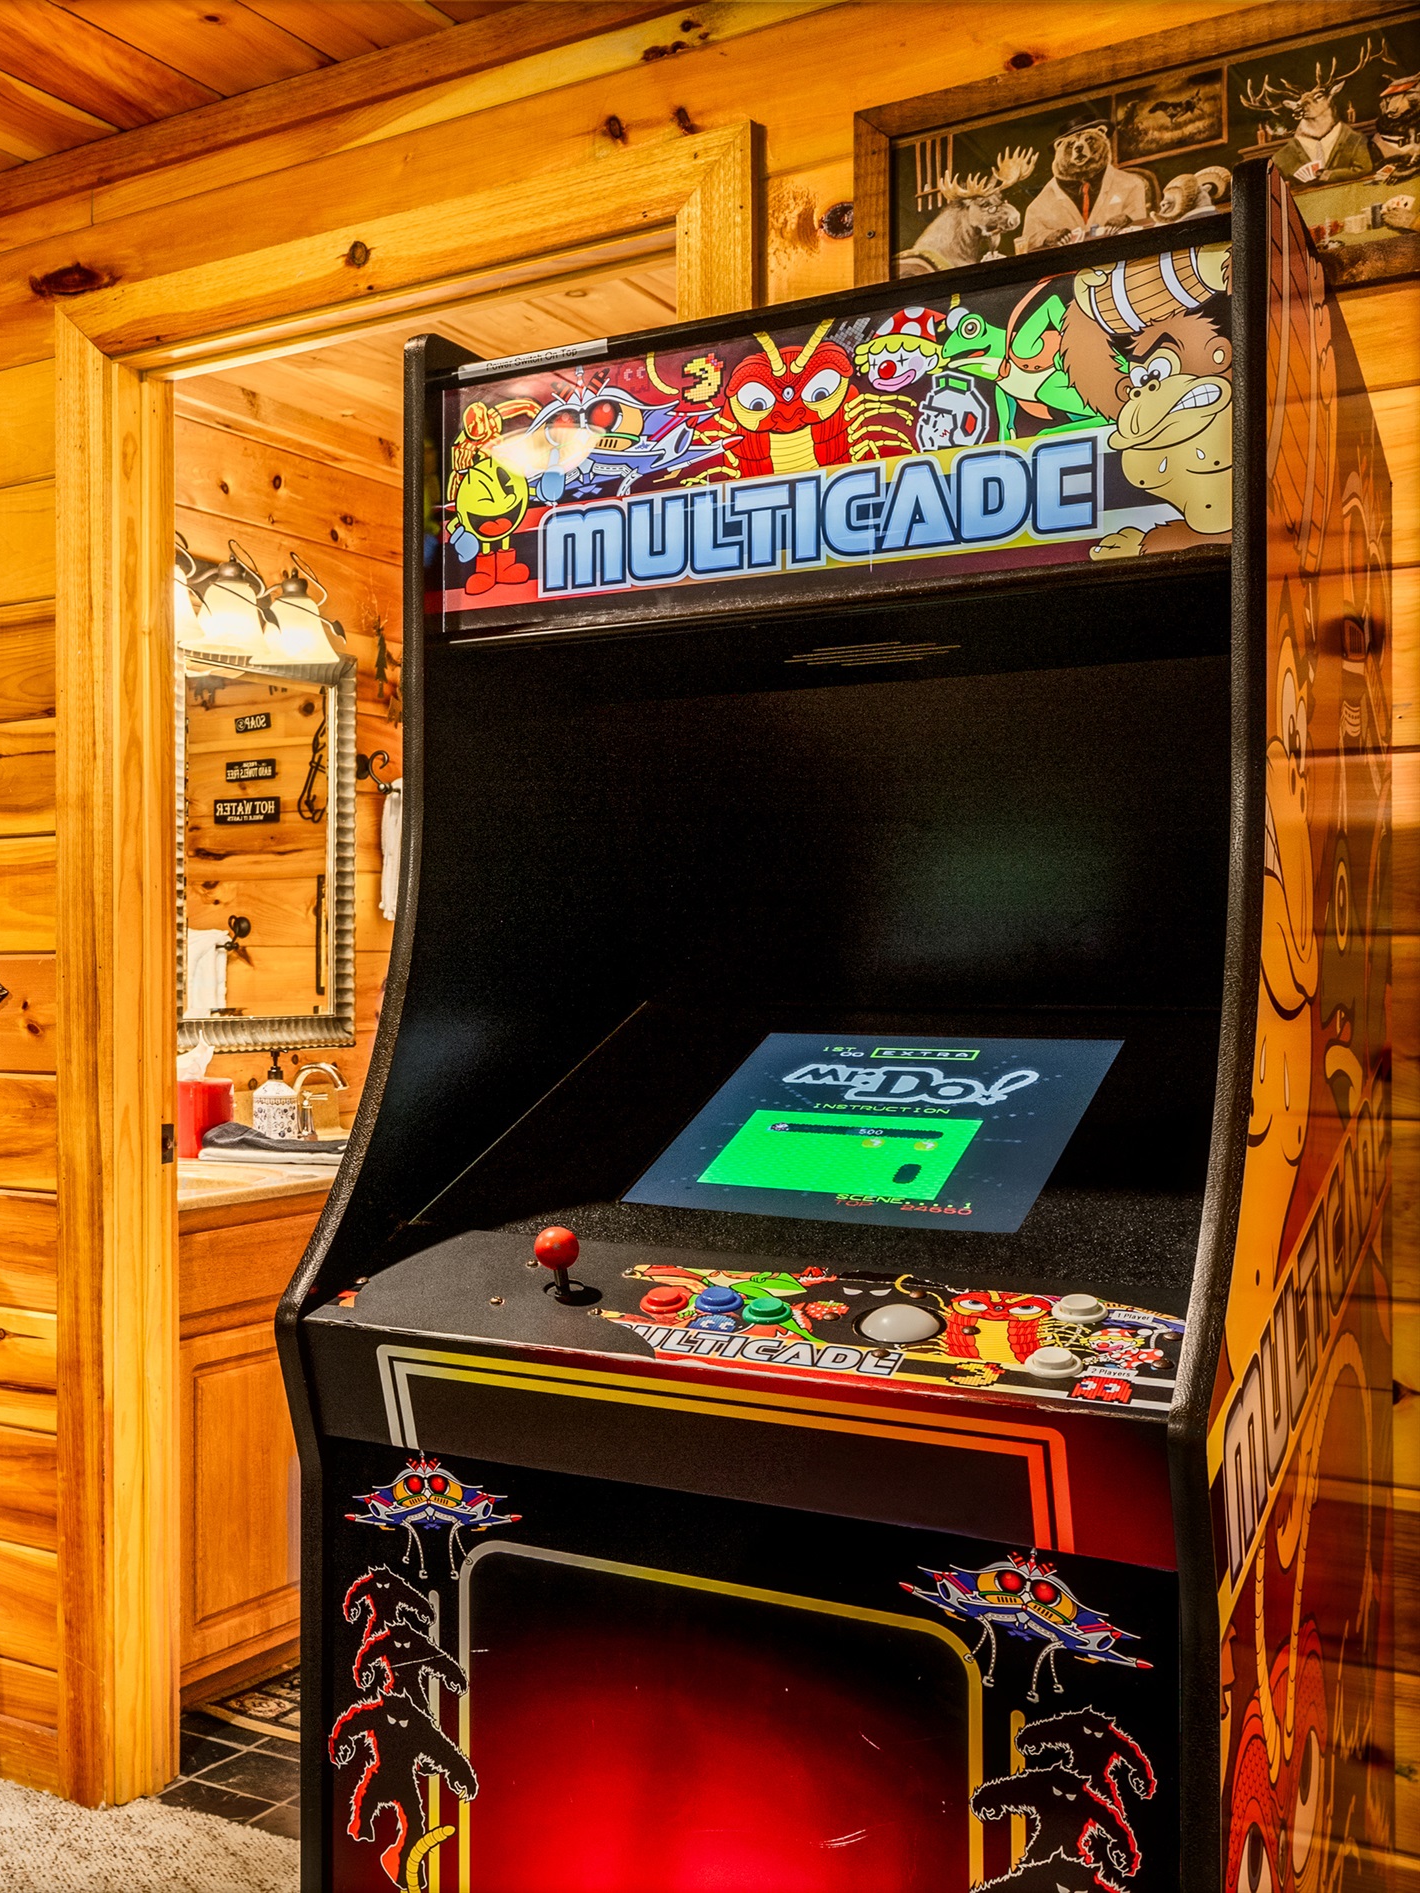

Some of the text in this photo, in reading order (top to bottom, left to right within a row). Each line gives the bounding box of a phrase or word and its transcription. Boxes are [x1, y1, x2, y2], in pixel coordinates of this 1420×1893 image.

[485, 348, 578, 372] Power Switch On Top
[538, 432, 1105, 597] MULTICADE
[882, 1050, 970, 1058] EXTRA
[813, 1103, 951, 1115] INSTRUCTION
[858, 1128, 884, 1136] 500
[835, 1199, 874, 1208] TOP
[1123, 1313, 1151, 1321] Player
[1222, 1075, 1391, 1597] MULTICADE
[623, 1322, 905, 1377] ULTICADE
[1098, 1369, 1132, 1378] Players
